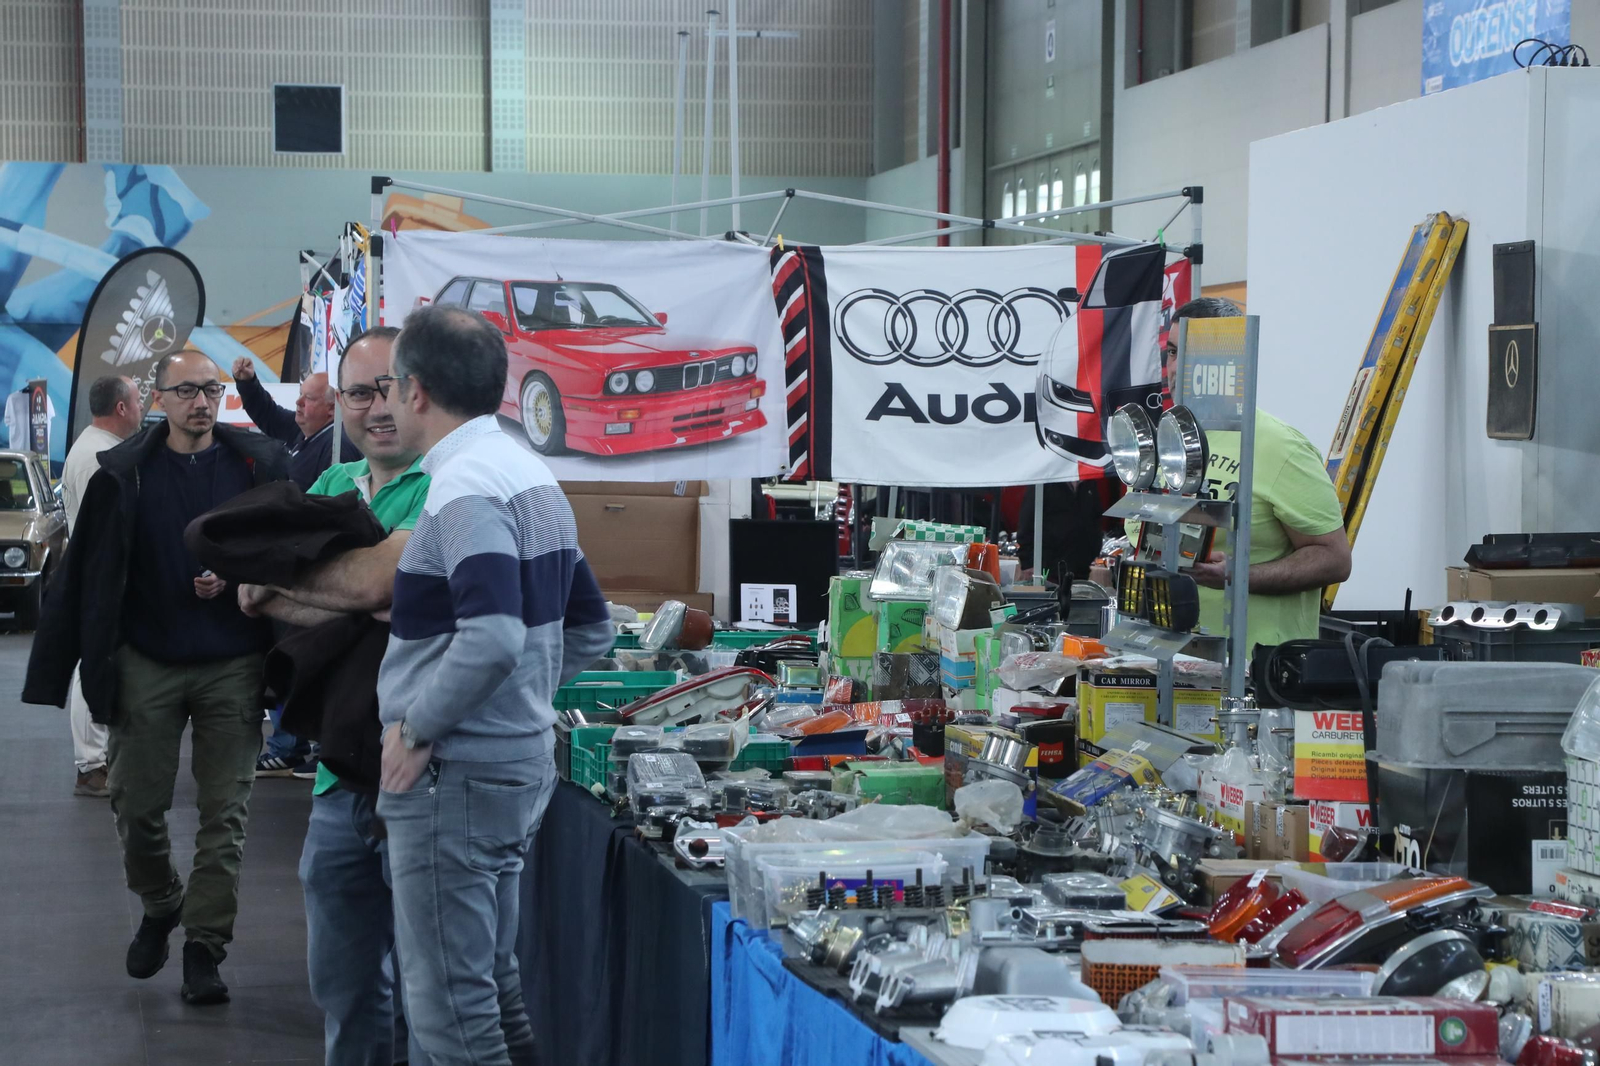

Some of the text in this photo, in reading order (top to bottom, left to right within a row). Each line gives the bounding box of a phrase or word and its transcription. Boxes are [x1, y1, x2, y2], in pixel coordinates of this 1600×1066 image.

[1449, 0, 1537, 68] OURENSE
[1192, 359, 1237, 396] CIBIÉ
[1208, 453, 1241, 475] RTH
[1101, 677, 1151, 686] CAR MIRROR
[1312, 711, 1364, 731] WEB
[1226, 784, 1244, 807] WEBER
[1522, 786, 1563, 795] 5 LITERS
[1512, 798, 1547, 808] LITROS
[1549, 798, 1554, 808] 5
[1315, 804, 1335, 826] WEBER
